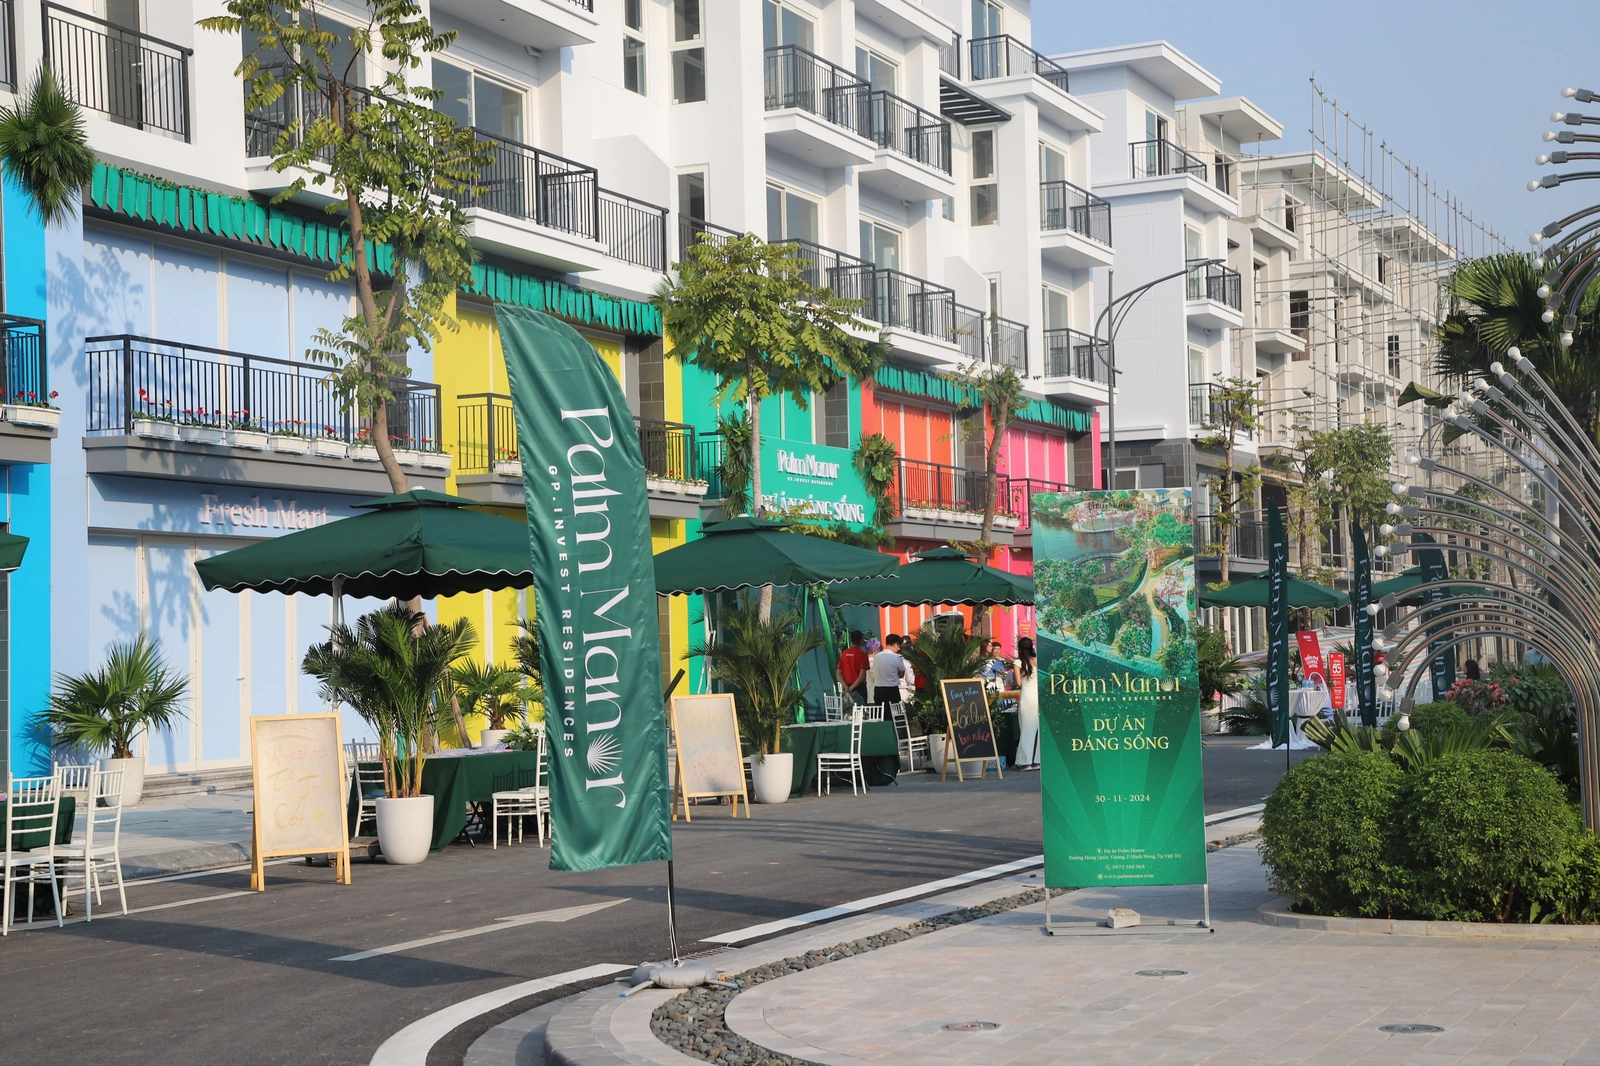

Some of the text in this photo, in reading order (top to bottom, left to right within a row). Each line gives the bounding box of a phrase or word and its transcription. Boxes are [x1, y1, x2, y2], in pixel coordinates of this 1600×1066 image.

[777, 449, 840, 480] Palm Manor
[200, 494, 330, 529] Fresh Mart
[834, 495, 865, 523] SỐNG
[1272, 542, 1284, 616] Palm
[548, 465, 575, 758] GP.INVEST RESIDENCES
[560, 406, 632, 809] Palm Manor
[1050, 672, 1187, 695] Palm Manor
[1094, 715, 1146, 734] DỰ ÁN
[1072, 732, 1170, 752] ĐÁNG SỐNG
[1095, 795, 1106, 803] 30
